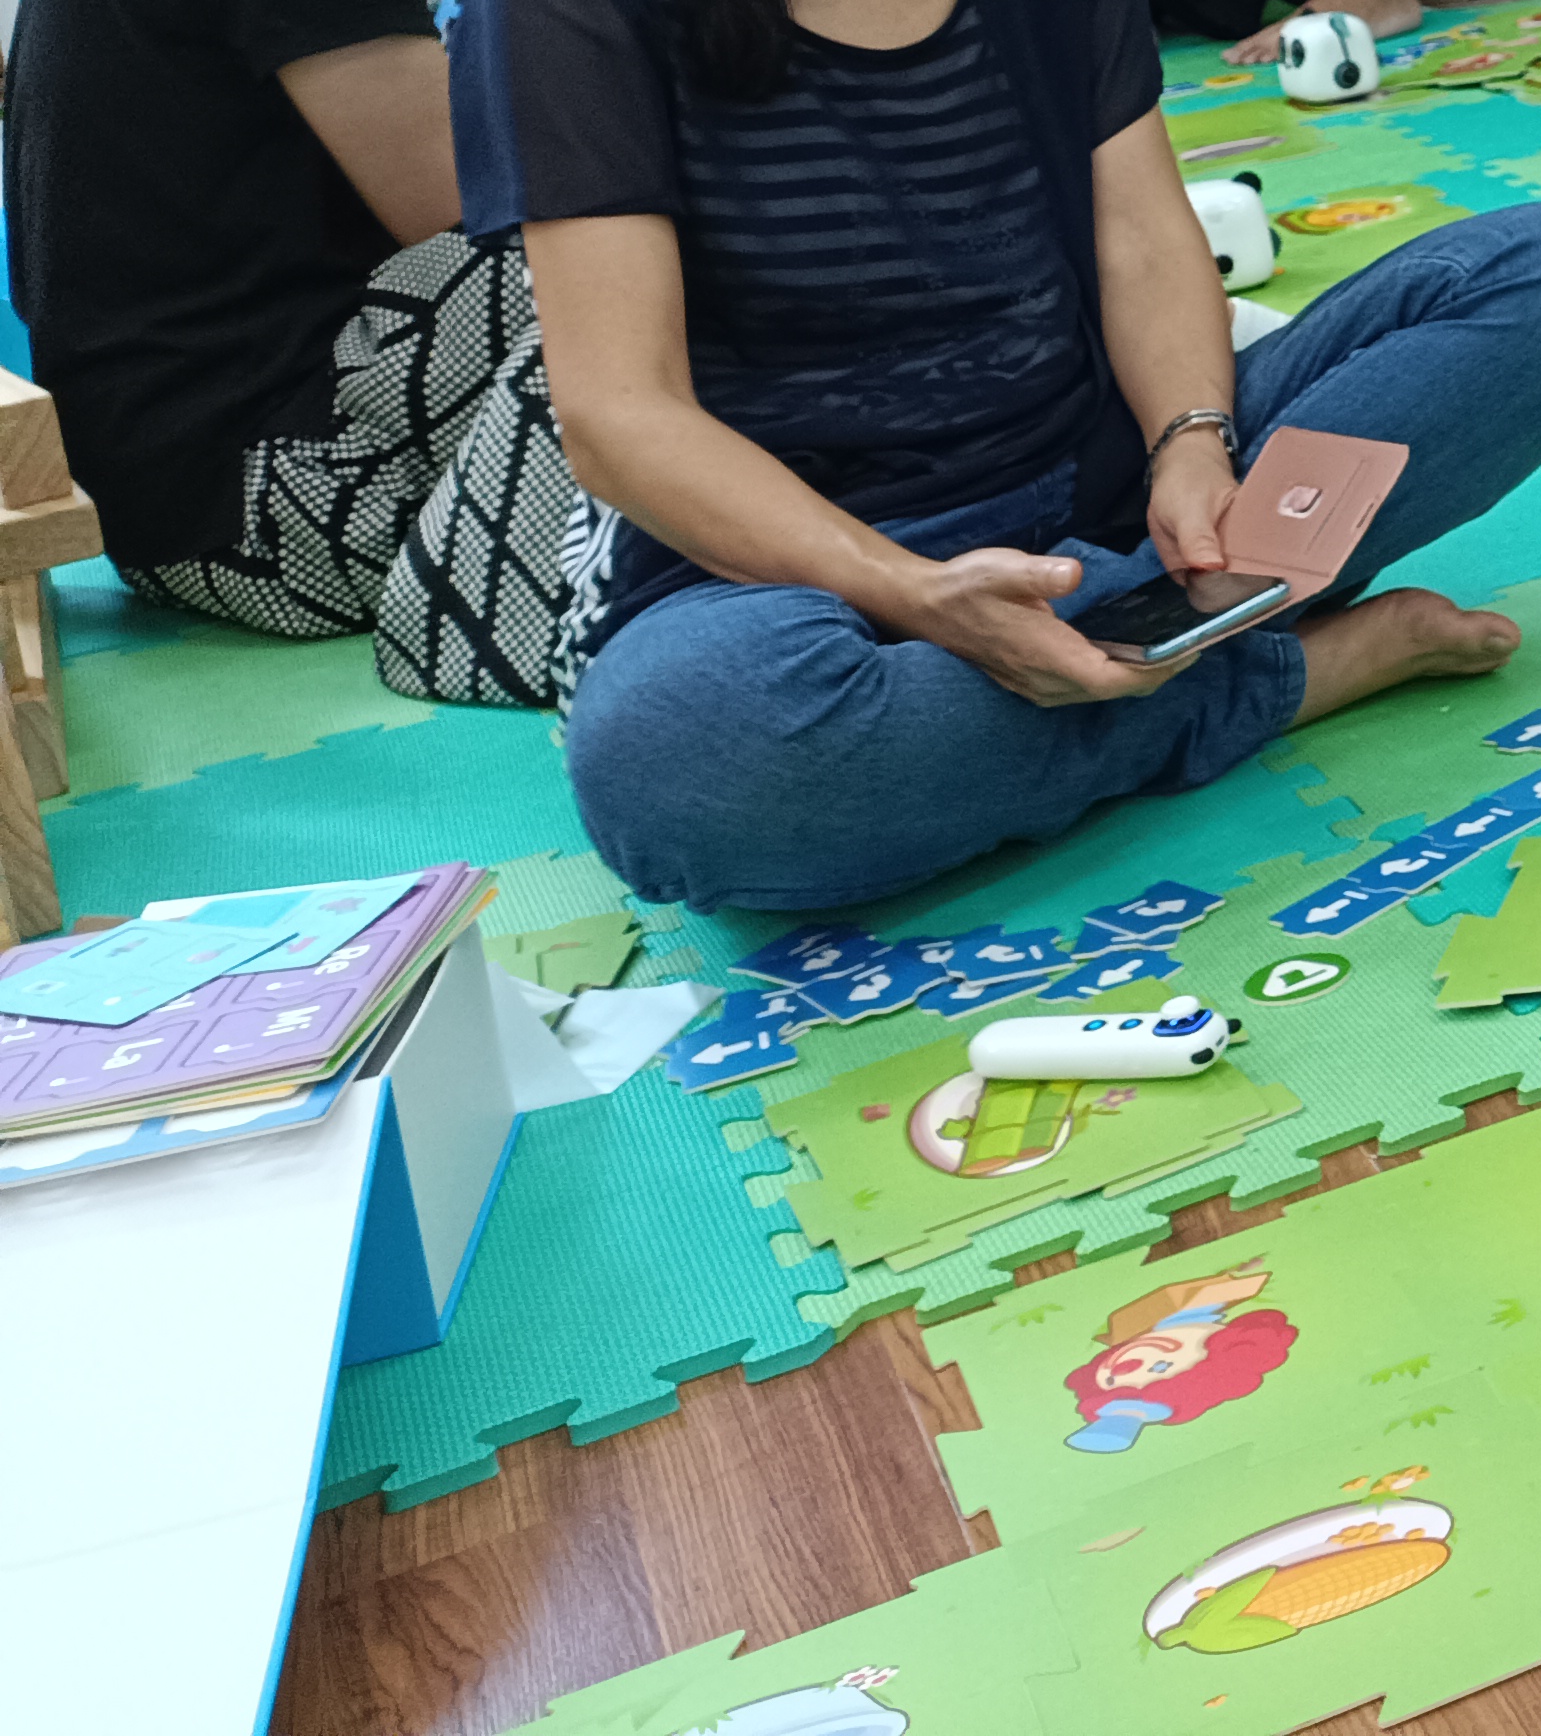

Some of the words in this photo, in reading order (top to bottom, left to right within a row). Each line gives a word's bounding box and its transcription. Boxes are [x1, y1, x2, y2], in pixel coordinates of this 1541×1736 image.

[314, 944, 371, 976] Re
[261, 1005, 321, 1037] Mi
[101, 1037, 164, 1071] La
